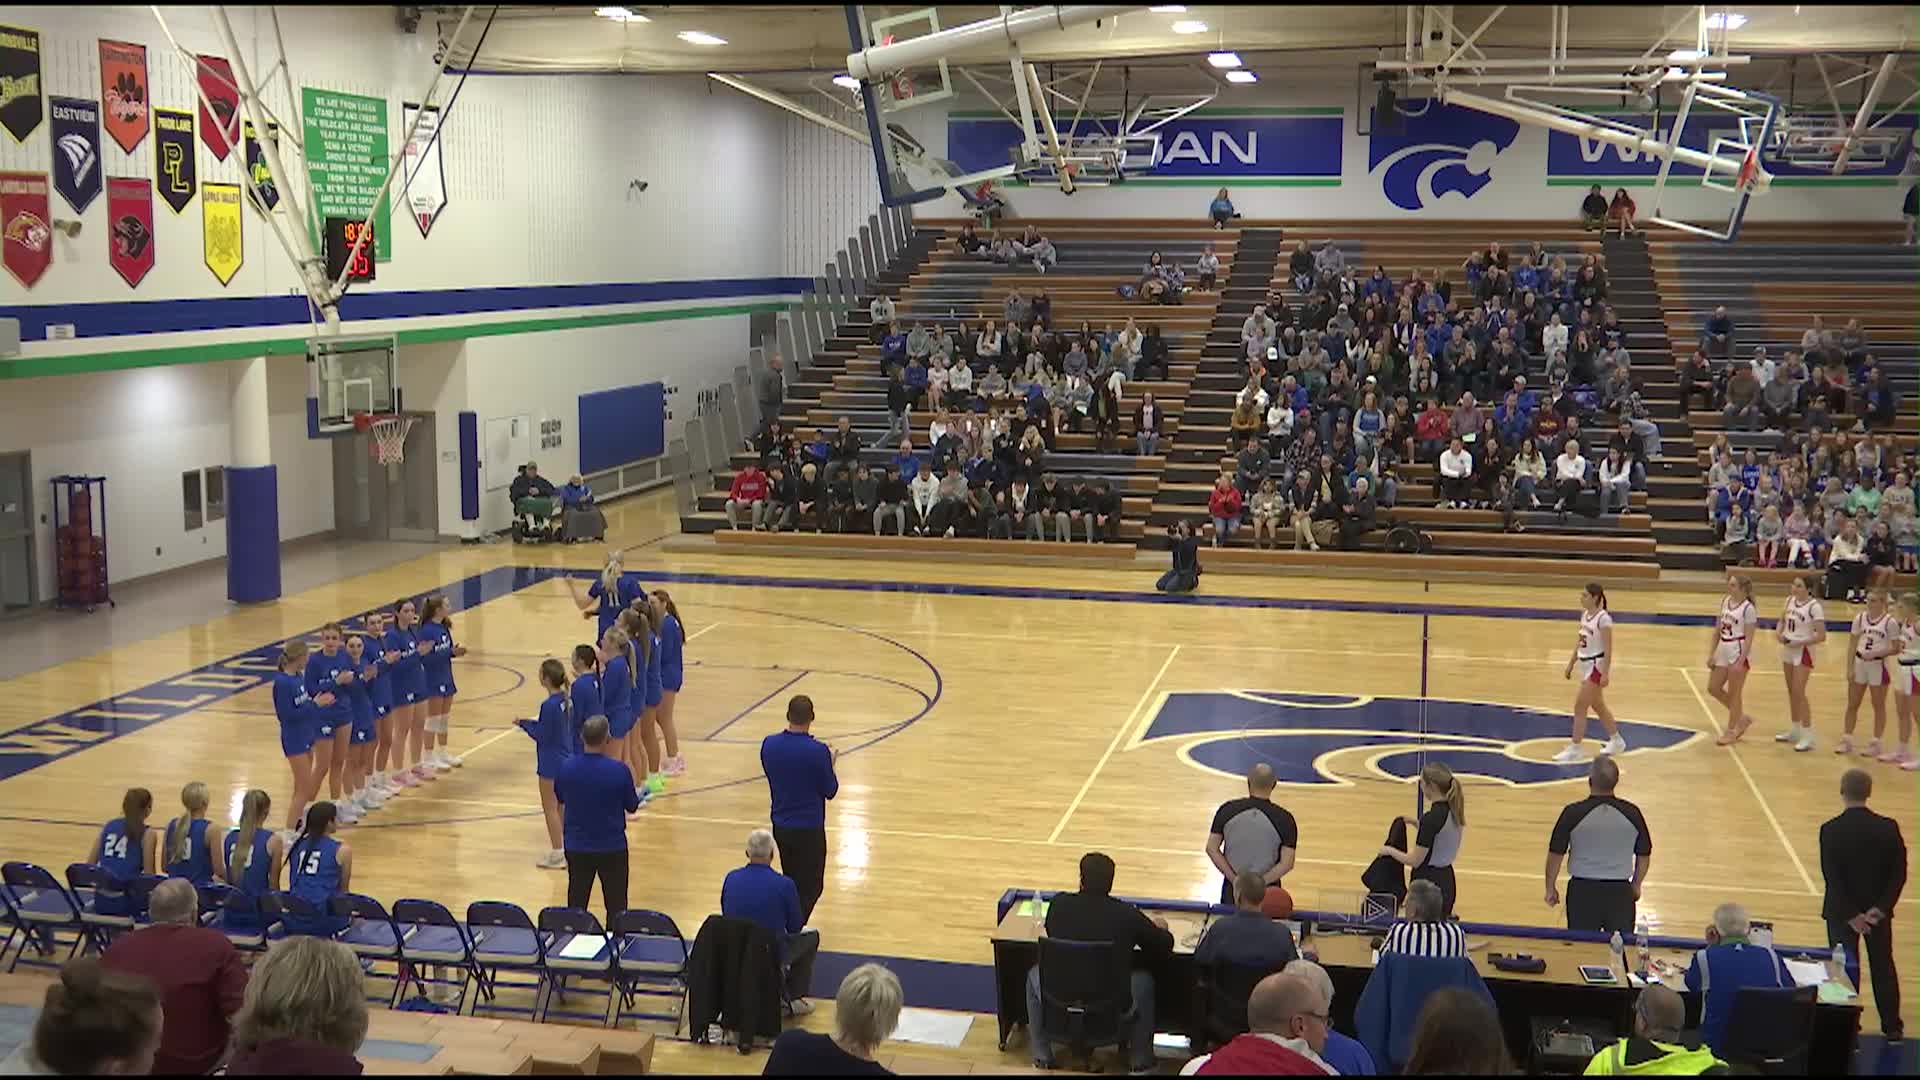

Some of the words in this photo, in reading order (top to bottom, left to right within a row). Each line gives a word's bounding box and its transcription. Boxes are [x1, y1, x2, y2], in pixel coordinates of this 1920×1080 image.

[53, 105, 96, 123] EASTVIEW
[1787, 618, 1796, 633] 11
[104, 834, 128, 858] 24
[296, 850, 321, 874] 15
